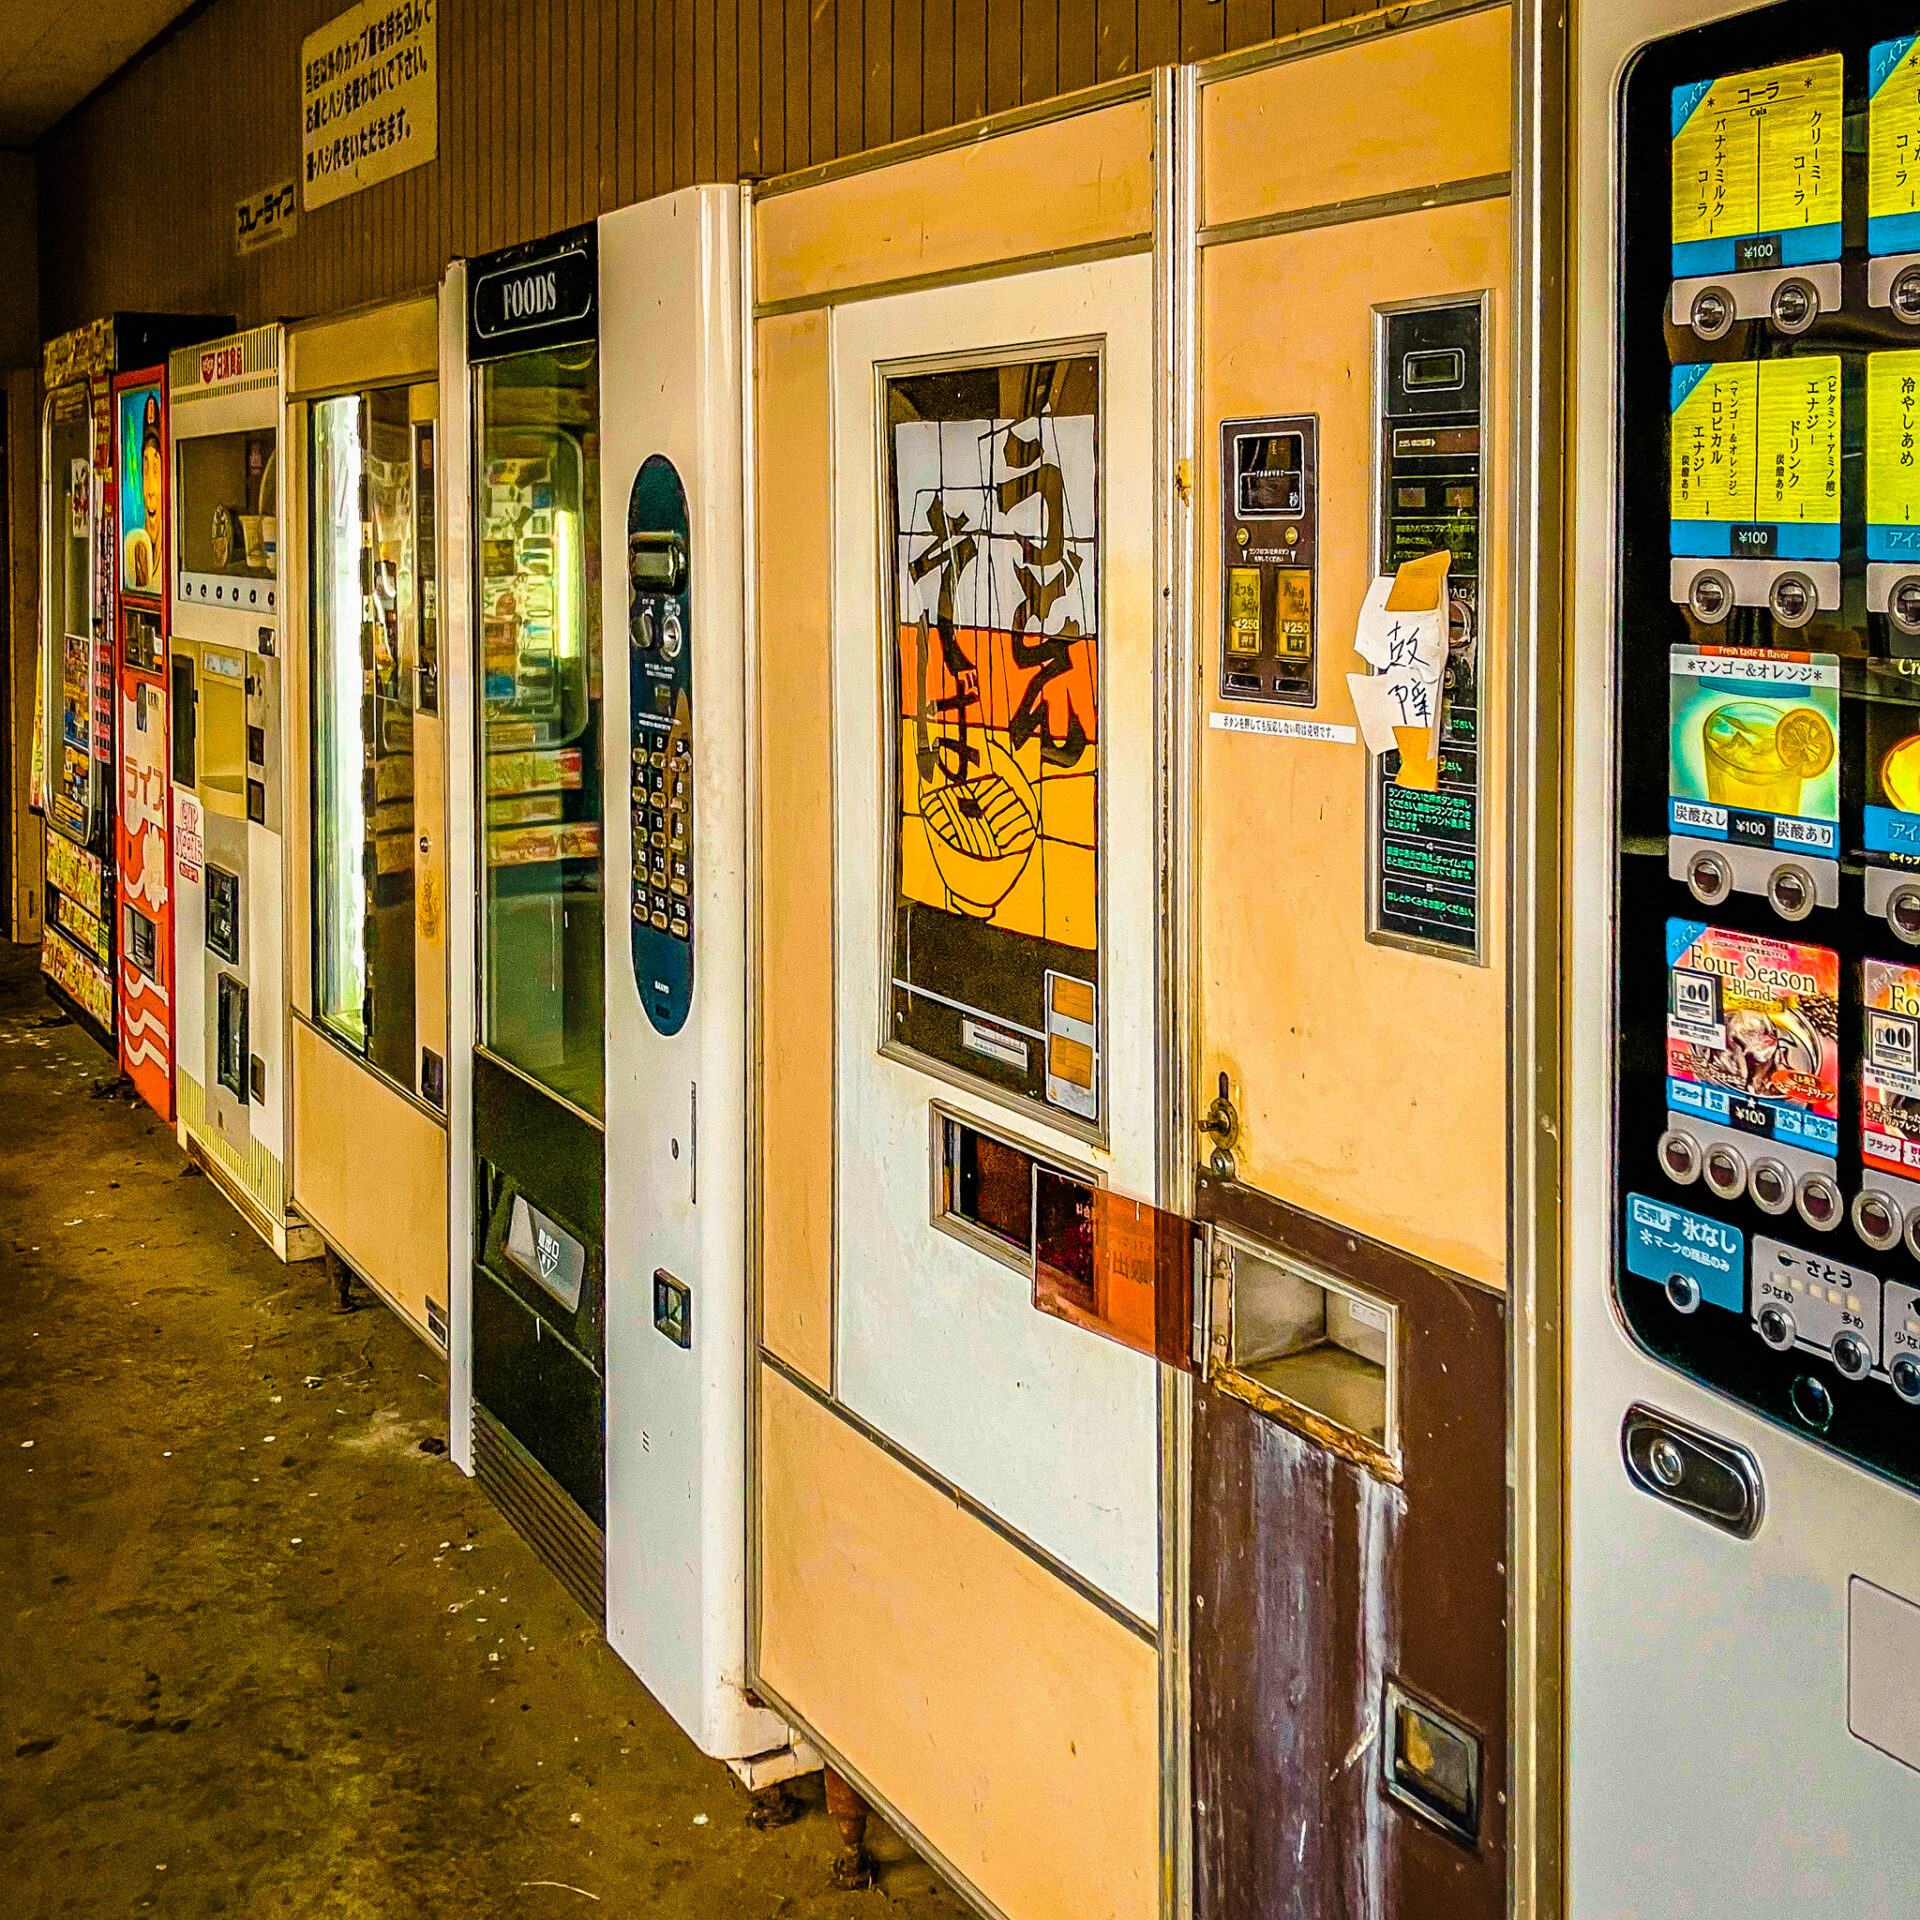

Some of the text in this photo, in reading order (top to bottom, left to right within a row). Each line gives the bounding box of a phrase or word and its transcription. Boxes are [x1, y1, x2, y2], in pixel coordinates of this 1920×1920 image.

[1879, 38, 1908, 77] アイス
[1679, 82, 1706, 116] アイス
[1738, 81, 1780, 105] コーラ
[1749, 105, 1767, 118] Cola
[1810, 110, 1823, 196] クリーミー
[1896, 133, 1910, 188] コーラ
[1713, 117, 1727, 218] バナナミルク
[1793, 156, 1806, 206] コーラ
[1697, 169, 1710, 218] コーラ
[1744, 243, 1774, 259] ¥100
[503, 271, 556, 321] FOODS
[1678, 364, 1705, 393] アイス
[1806, 380, 1819, 446] エナジー
[1901, 376, 1916, 469] 冷やしあめ
[1710, 382, 1724, 465] トロピカル
[1693, 425, 1706, 488] エナジー
[1788, 419, 1803, 490] ドリンク
[1680, 455, 1690, 502] 炭酸あり
[1775, 454, 1785, 503] 炭酸あり
[1738, 530, 1768, 546] ¥100
[1283, 621, 1309, 634] ¥250
[1718, 645, 1738, 657] Fresh
[1758, 649, 1766, 661] &
[1766, 650, 1790, 663] flavor
[638, 732, 644, 745] 1
[657, 736, 664, 750] 2
[676, 741, 683, 753] 3
[637, 771, 643, 784] 4
[656, 777, 663, 790] 5
[676, 782, 683, 795] 6
[637, 812, 643, 825] 7
[656, 816, 663, 829] 8
[1675, 804, 1726, 828] 炭酸なし
[676, 822, 683, 835] 9
[1735, 820, 1767, 837] ¥100
[1776, 821, 1833, 846] 炭酸あり
[1890, 822, 1920, 841] アイ
[1426, 841, 1434, 851] 4
[637, 850, 647, 863] 10
[655, 856, 665, 869] 11
[674, 862, 686, 875] 12
[637, 889, 647, 902] 13
[1425, 882, 1434, 893] 5
[655, 896, 665, 909] 14
[674, 903, 687, 917] 15
[1689, 943, 1739, 978] Four
[1743, 954, 1817, 995] Season
[1732, 978, 1772, 1002] Blend
[1736, 1106, 1767, 1127] ¥100
[1869, 1137, 1898, 1153] ブラック
[1683, 1215, 1737, 1254] 氷なし
[1807, 1259, 1853, 1289] さとう
[1761, 1282, 1794, 1304] 少なめ
[1841, 1311, 1864, 1330] 多め
[1894, 1330, 1920, 1350] 少な
